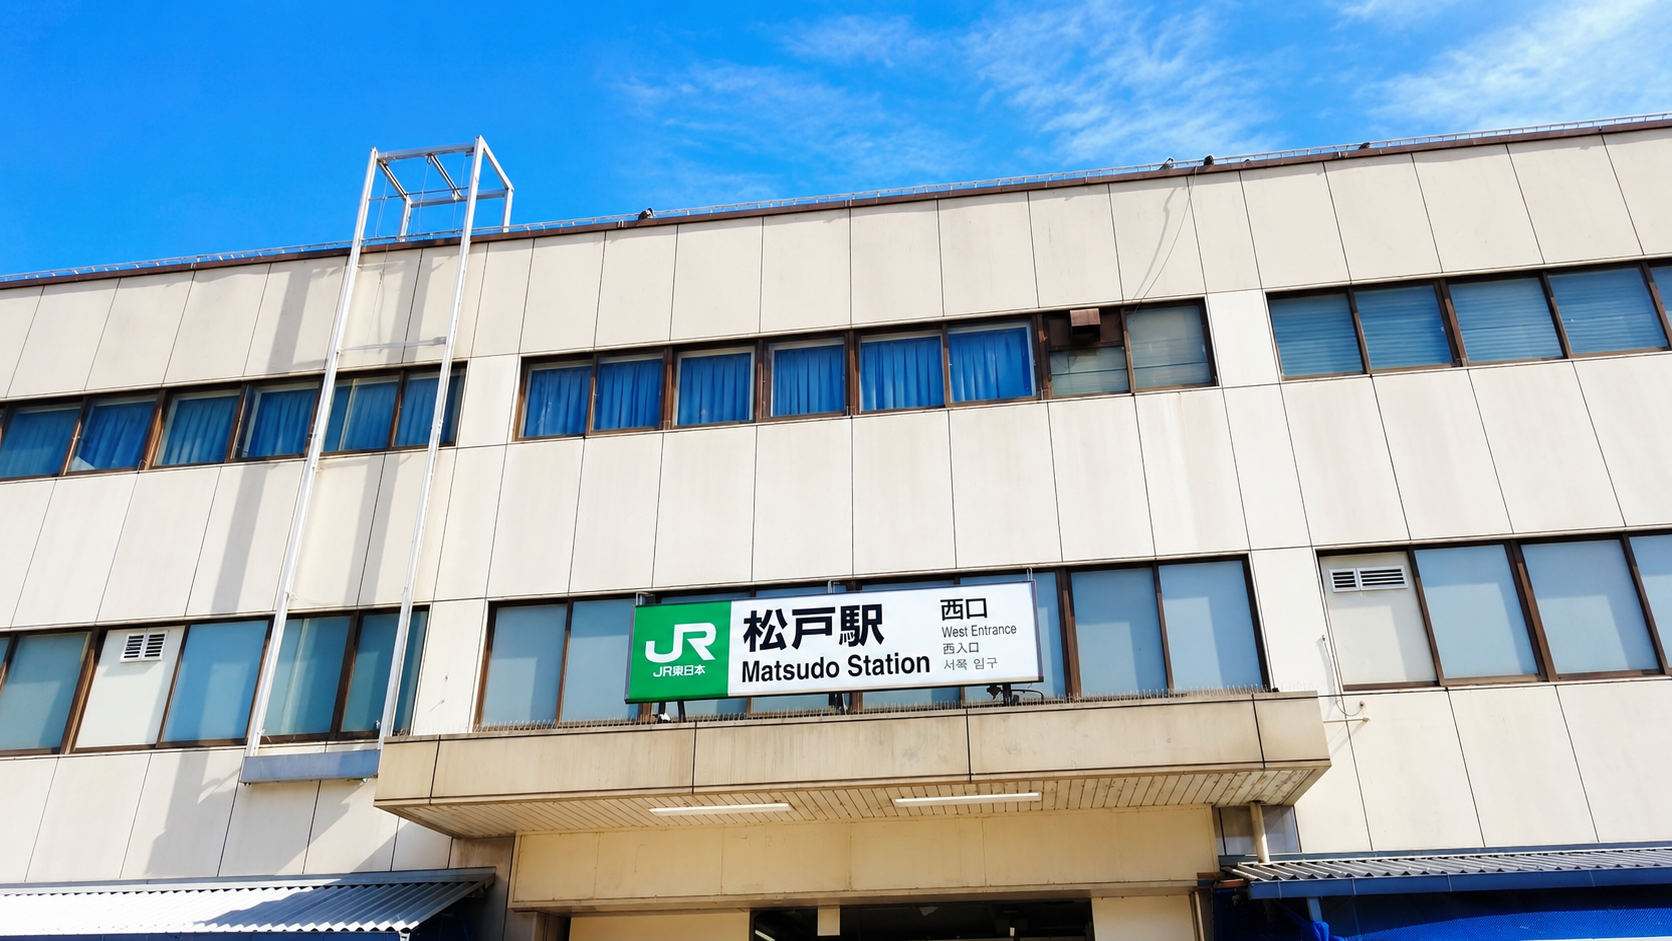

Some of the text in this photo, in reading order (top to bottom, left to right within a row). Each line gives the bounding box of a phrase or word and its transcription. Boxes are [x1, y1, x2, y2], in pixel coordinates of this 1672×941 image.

[940, 598, 987, 621] 西口
[743, 603, 885, 652] 松戸駅
[941, 624, 1017, 639] West Entrance
[645, 622, 717, 664] JR
[942, 642, 979, 655] 西入口
[653, 664, 706, 678] JR東日本
[742, 653, 931, 683] Matsudo Station
